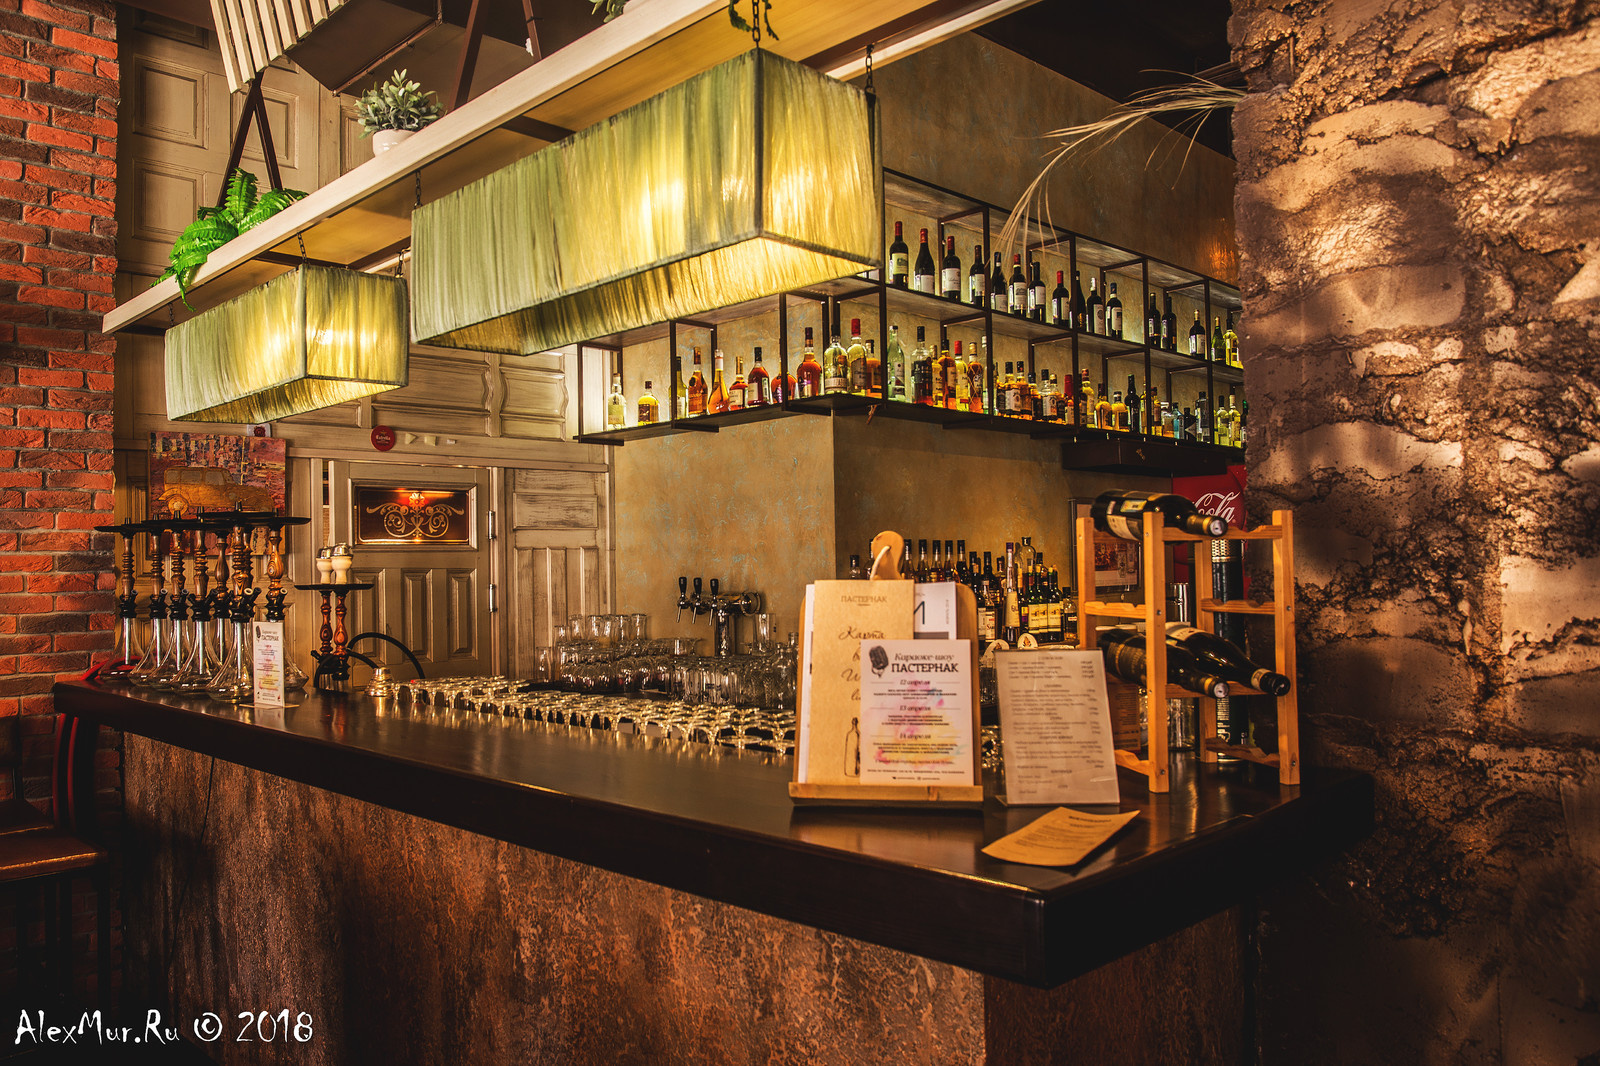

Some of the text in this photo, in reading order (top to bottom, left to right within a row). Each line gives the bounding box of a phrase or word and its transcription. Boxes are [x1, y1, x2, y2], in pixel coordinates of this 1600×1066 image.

[840, 595, 888, 603] ПАСТЕРНАК
[894, 653, 955, 663] Караоке-шоу
[891, 663, 959, 673] ПАСТЕРНАК
